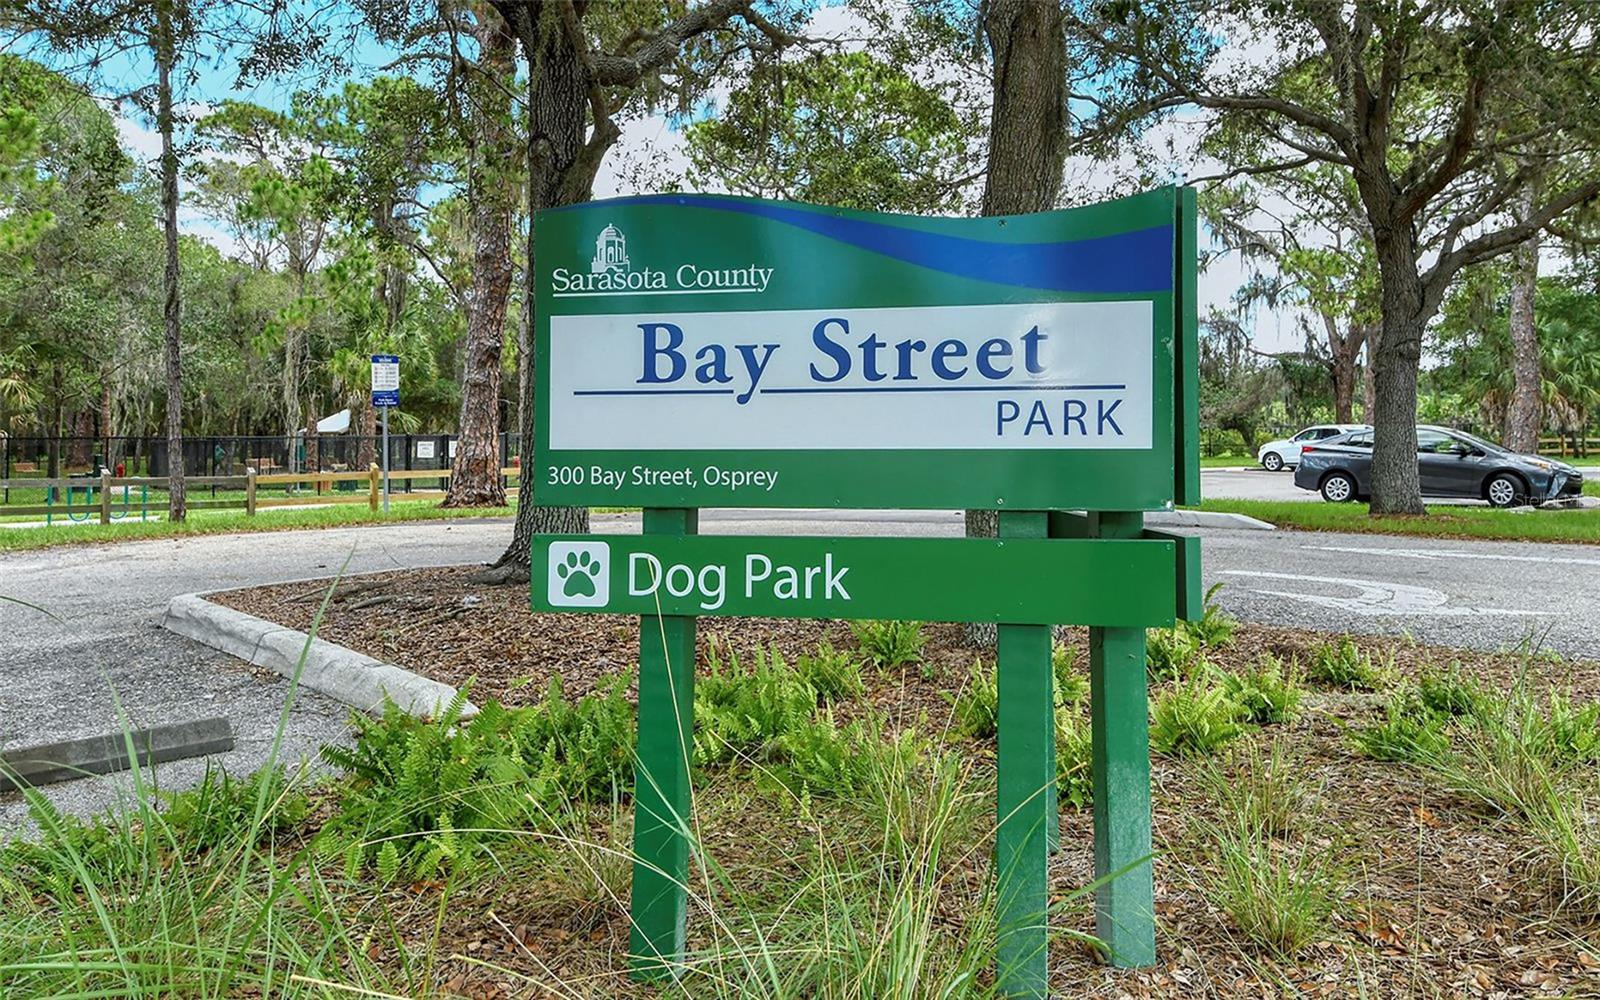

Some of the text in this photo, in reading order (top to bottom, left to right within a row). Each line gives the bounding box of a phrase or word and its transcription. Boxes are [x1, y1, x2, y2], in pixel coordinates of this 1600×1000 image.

[552, 264, 774, 292] Sarasota County
[636, 317, 1049, 404] Bay Street
[996, 399, 1124, 436] PARK
[548, 466, 779, 491] 300 Bay Street, Osprey
[628, 552, 851, 610] Dog Park
